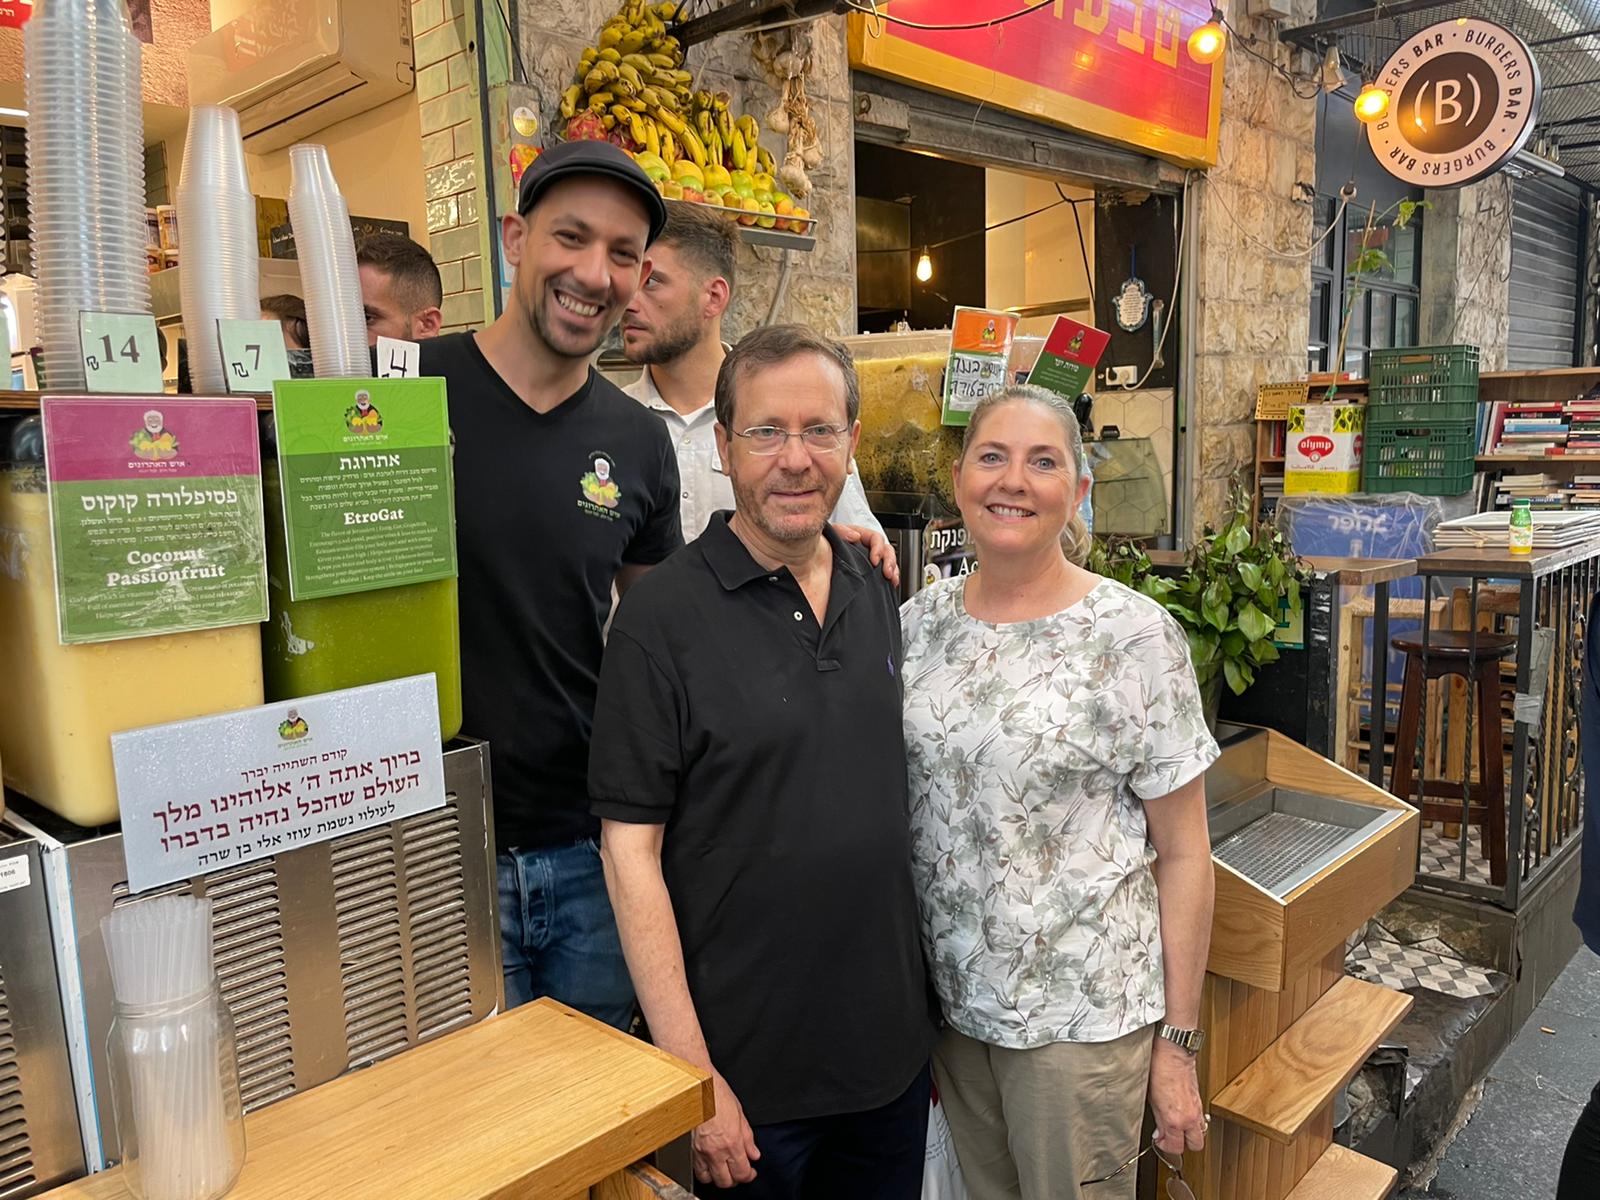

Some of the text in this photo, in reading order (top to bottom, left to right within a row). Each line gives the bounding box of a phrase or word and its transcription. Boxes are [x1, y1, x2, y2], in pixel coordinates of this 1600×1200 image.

[1412, 33, 1444, 58] BAR
[1465, 29, 1522, 120] BURGERS BAR
[1389, 139, 1496, 176] BURGERS BAR
[98, 334, 140, 363] 14
[244, 344, 261, 371] 7
[1300, 438, 1332, 451] olymp
[340, 454, 401, 471] אתרוגת
[80, 485, 238, 515] פסיפלורה קוקוס
[343, 508, 405, 525] EtroGat
[126, 548, 205, 565] Coconut
[106, 564, 226, 588] Passionfruit
[241, 749, 348, 784] קודם השתייה יברך
[329, 761, 373, 785] אתה
[380, 750, 421, 777] ברוך
[210, 780, 292, 813] אלוהינו
[153, 801, 202, 833] מלך
[160, 773, 420, 853] העולם שהכל נהיה בדברו
[198, 800, 396, 868] לעילוי נשמת עוזי אלי בן שרה
